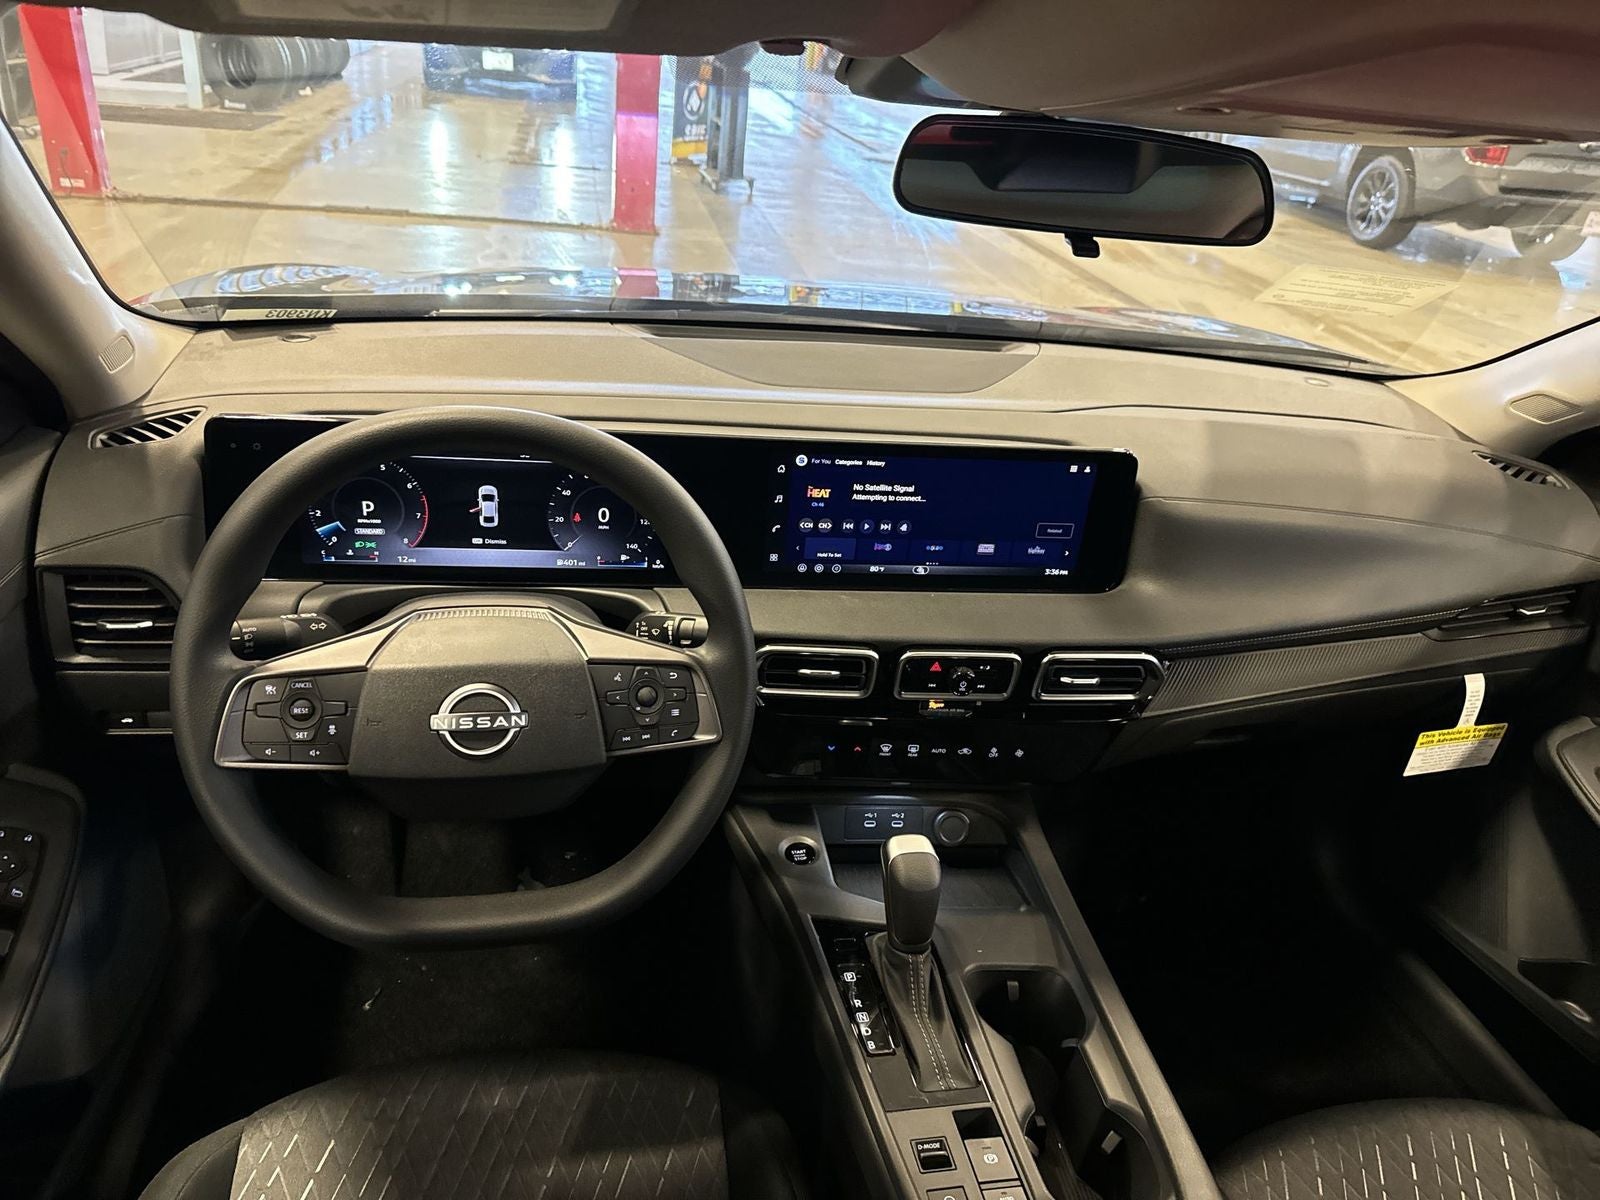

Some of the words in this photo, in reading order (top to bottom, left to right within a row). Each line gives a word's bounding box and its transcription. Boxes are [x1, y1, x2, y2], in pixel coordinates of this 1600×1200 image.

[808, 488, 831, 498] HEAT
[893, 485, 914, 493] Signal
[852, 494, 888, 502] Attempting
[362, 500, 374, 516] P
[598, 508, 610, 522] 0
[433, 714, 526, 730] NISSAN
[1438, 729, 1463, 737] Vehicle
[1473, 724, 1506, 734] Equipped
[1436, 735, 1469, 743] Advanced
[854, 999, 863, 1008] R
[863, 1026, 872, 1036] D
[867, 1040, 876, 1050] B
[918, 1142, 941, 1150] D-MODE
